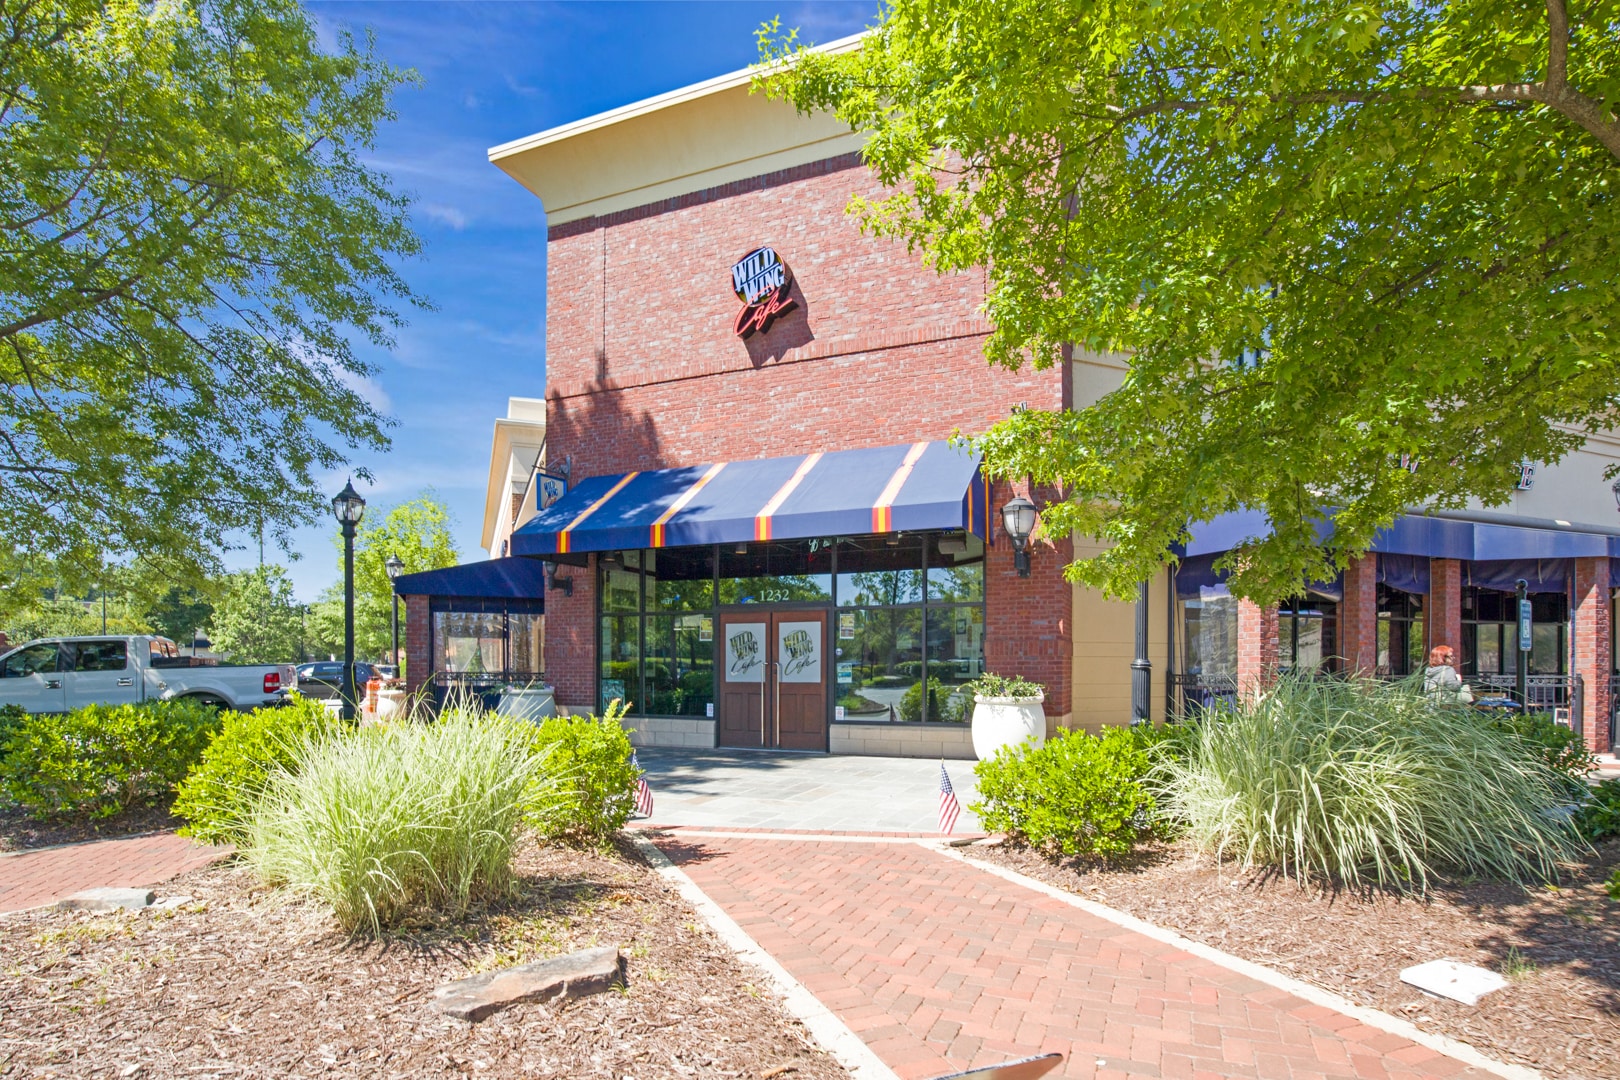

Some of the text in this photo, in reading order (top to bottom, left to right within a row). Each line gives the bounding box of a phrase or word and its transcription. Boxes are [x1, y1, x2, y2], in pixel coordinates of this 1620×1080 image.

[731, 246, 775, 292] WILD
[741, 263, 785, 305] WING
[760, 589, 790, 602] 1232
[730, 631, 753, 650] WILD
[736, 641, 759, 660] WING
[783, 630, 808, 651] WILD
[789, 640, 814, 660] WING
